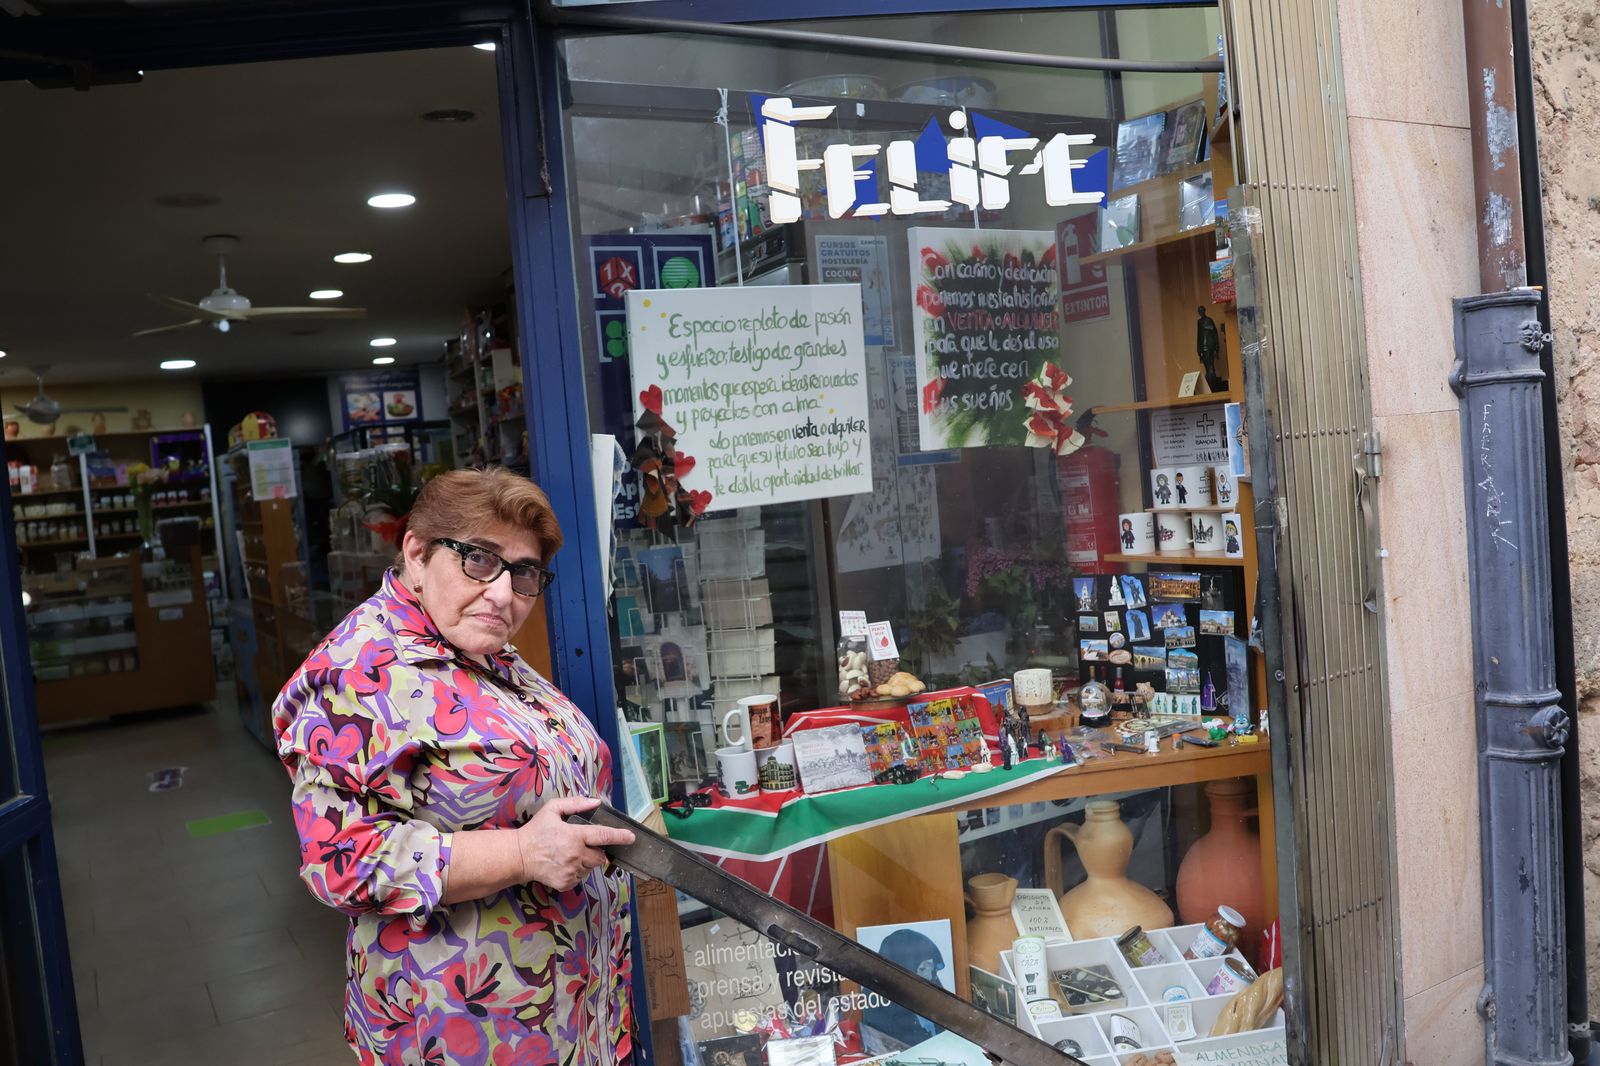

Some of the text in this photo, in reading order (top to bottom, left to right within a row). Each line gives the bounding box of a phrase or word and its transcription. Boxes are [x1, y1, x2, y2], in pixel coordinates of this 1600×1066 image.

[821, 241, 856, 249] CURSOS
[821, 249, 871, 257] GRATUITOS
[825, 270, 858, 278] COCINA
[923, 253, 955, 280] Con
[1065, 295, 1108, 314] EXTINTOR
[668, 305, 851, 349] Espacio repleto de pasión
[947, 309, 995, 331] VENTA
[656, 352, 669, 380] y
[728, 337, 771, 371] testigo
[771, 342, 792, 360] de
[790, 336, 848, 371] grandes
[960, 335, 988, 361] que
[1002, 333, 1022, 352] des
[1037, 335, 1060, 350] uso
[663, 378, 718, 405] momentos
[720, 381, 741, 402] que
[741, 377, 781, 401] espera
[781, 371, 808, 393] ideas
[962, 384, 1013, 411] sueños
[676, 411, 687, 434] y
[692, 403, 750, 431] proyectos
[752, 403, 778, 422] con
[732, 433, 776, 455] ponemos
[776, 430, 791, 443] en
[791, 416, 819, 439] venta
[820, 424, 827, 436] o
[706, 453, 736, 478] para
[736, 453, 758, 472] que
[774, 444, 807, 467] futuro
[807, 442, 827, 457] sea
[826, 440, 850, 459] tuyo
[852, 437, 863, 456] y
[713, 475, 726, 495] te
[727, 475, 750, 494] des
[749, 472, 762, 491] la
[763, 463, 821, 496] oportunidad
[821, 464, 833, 480] de
[694, 941, 800, 967] alimentaci
[697, 974, 764, 1004] prensa
[768, 971, 781, 994] y
[701, 990, 892, 1033] apuestas del estado
